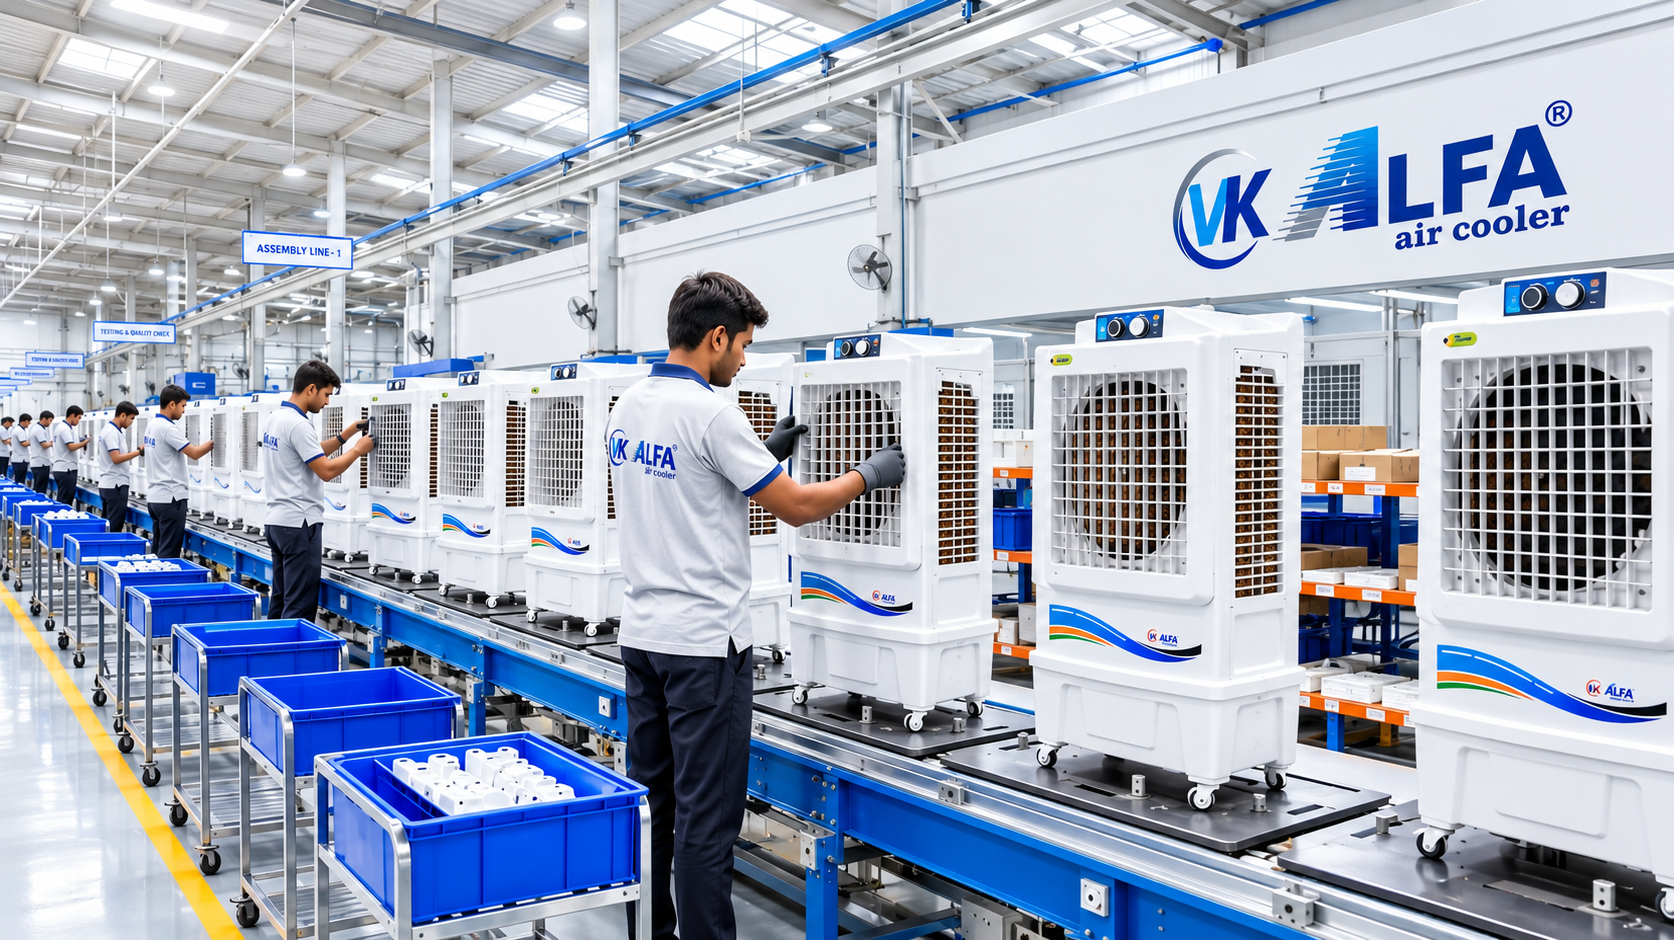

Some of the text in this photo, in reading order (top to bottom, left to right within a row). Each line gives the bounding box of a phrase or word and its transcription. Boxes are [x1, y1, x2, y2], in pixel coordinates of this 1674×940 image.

[1394, 202, 1570, 251] air cooler
[256, 244, 308, 256] ASSEMBLY
[653, 470, 677, 480] cooler
[1159, 633, 1178, 644] ALFA
[1603, 683, 1635, 700] ALFA
